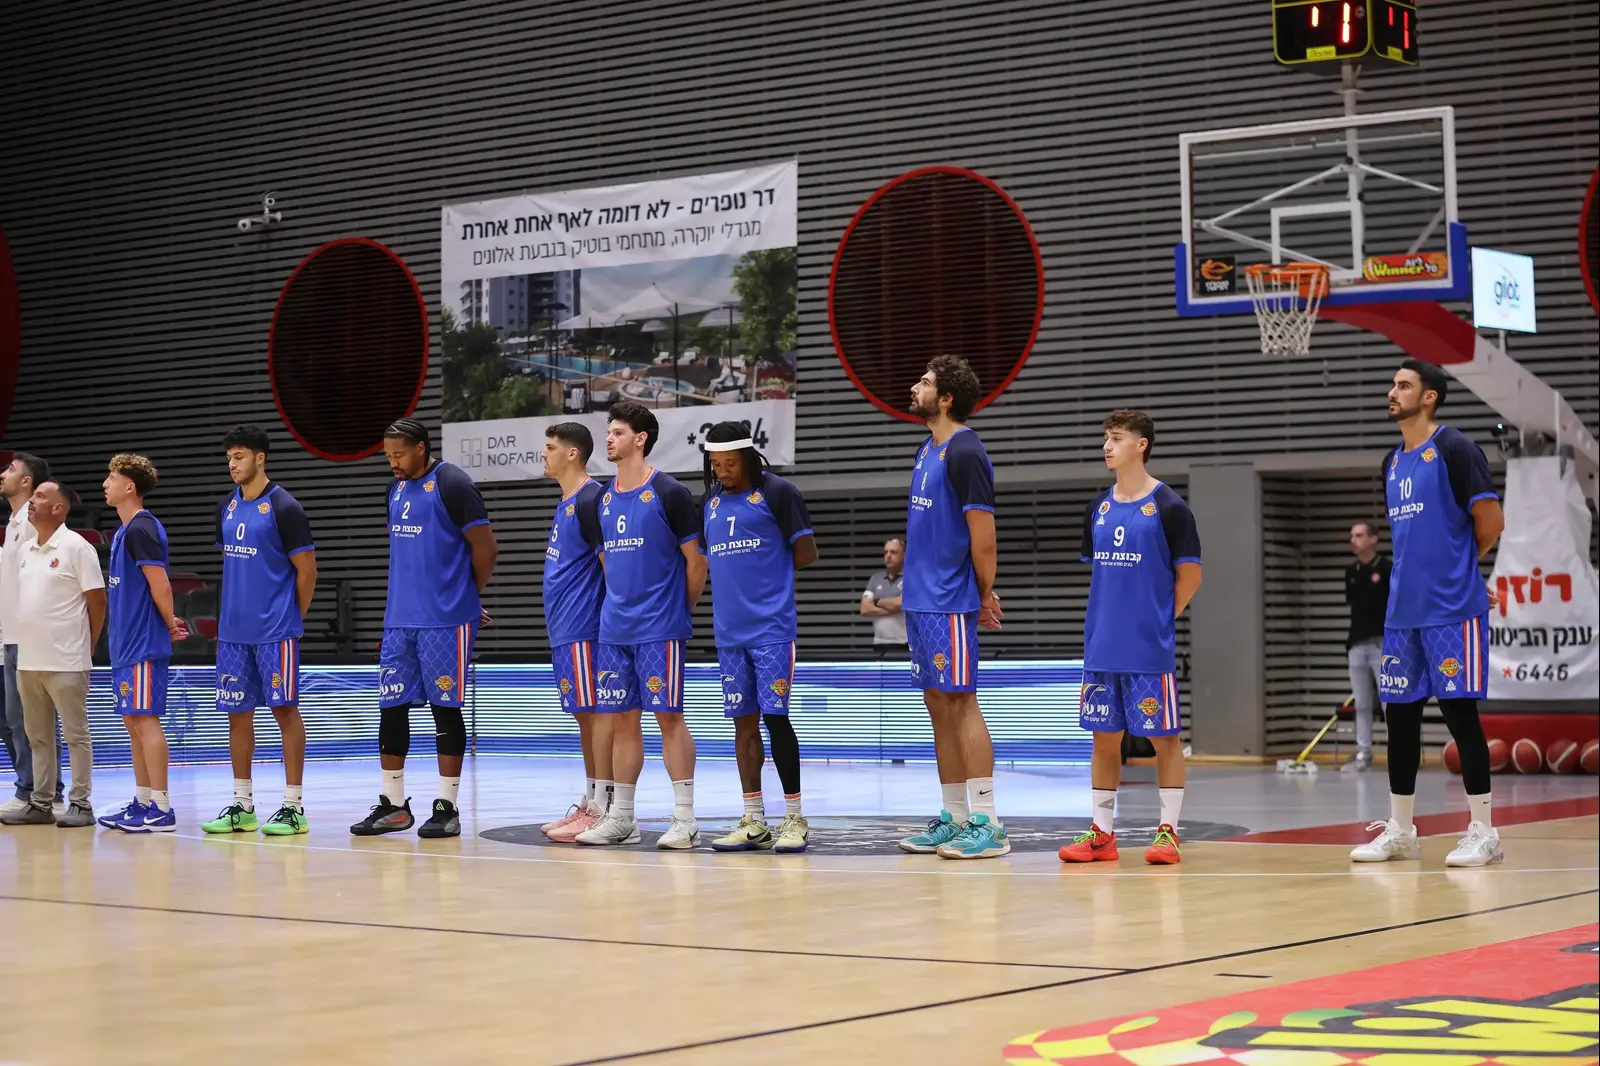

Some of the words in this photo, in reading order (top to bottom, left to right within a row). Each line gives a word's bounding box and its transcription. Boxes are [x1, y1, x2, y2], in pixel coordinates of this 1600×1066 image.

[690, 191, 746, 215] נופרים
[752, 188, 775, 207] דר
[598, 204, 641, 225] דומה
[646, 199, 671, 220] לא
[461, 219, 509, 241] אחרת
[514, 214, 553, 234] אחת
[558, 208, 593, 232] לאף
[721, 220, 762, 239] מגדלי
[616, 231, 665, 251] מתחמי
[671, 225, 715, 247] יוקרה,
[473, 246, 515, 266] אלונים
[519, 241, 567, 261] בגבעת
[571, 236, 611, 260] בוטיק
[1373, 262, 1425, 277] Winner
[487, 435, 517, 449] DAR
[487, 450, 543, 467] NOFARI
[1399, 477, 1412, 500] 10
[401, 501, 410, 519] 2
[236, 522, 245, 541] 0
[551, 523, 558, 543] 5
[617, 515, 626, 534] 6
[726, 516, 736, 536] 7
[617, 537, 644, 547] קבוצת
[728, 538, 761, 550] קבוצת
[1113, 525, 1125, 547] 9
[1094, 551, 1109, 560] כנע
[1111, 552, 1142, 564] קבוצת
[1552, 626, 1592, 654] ענק
